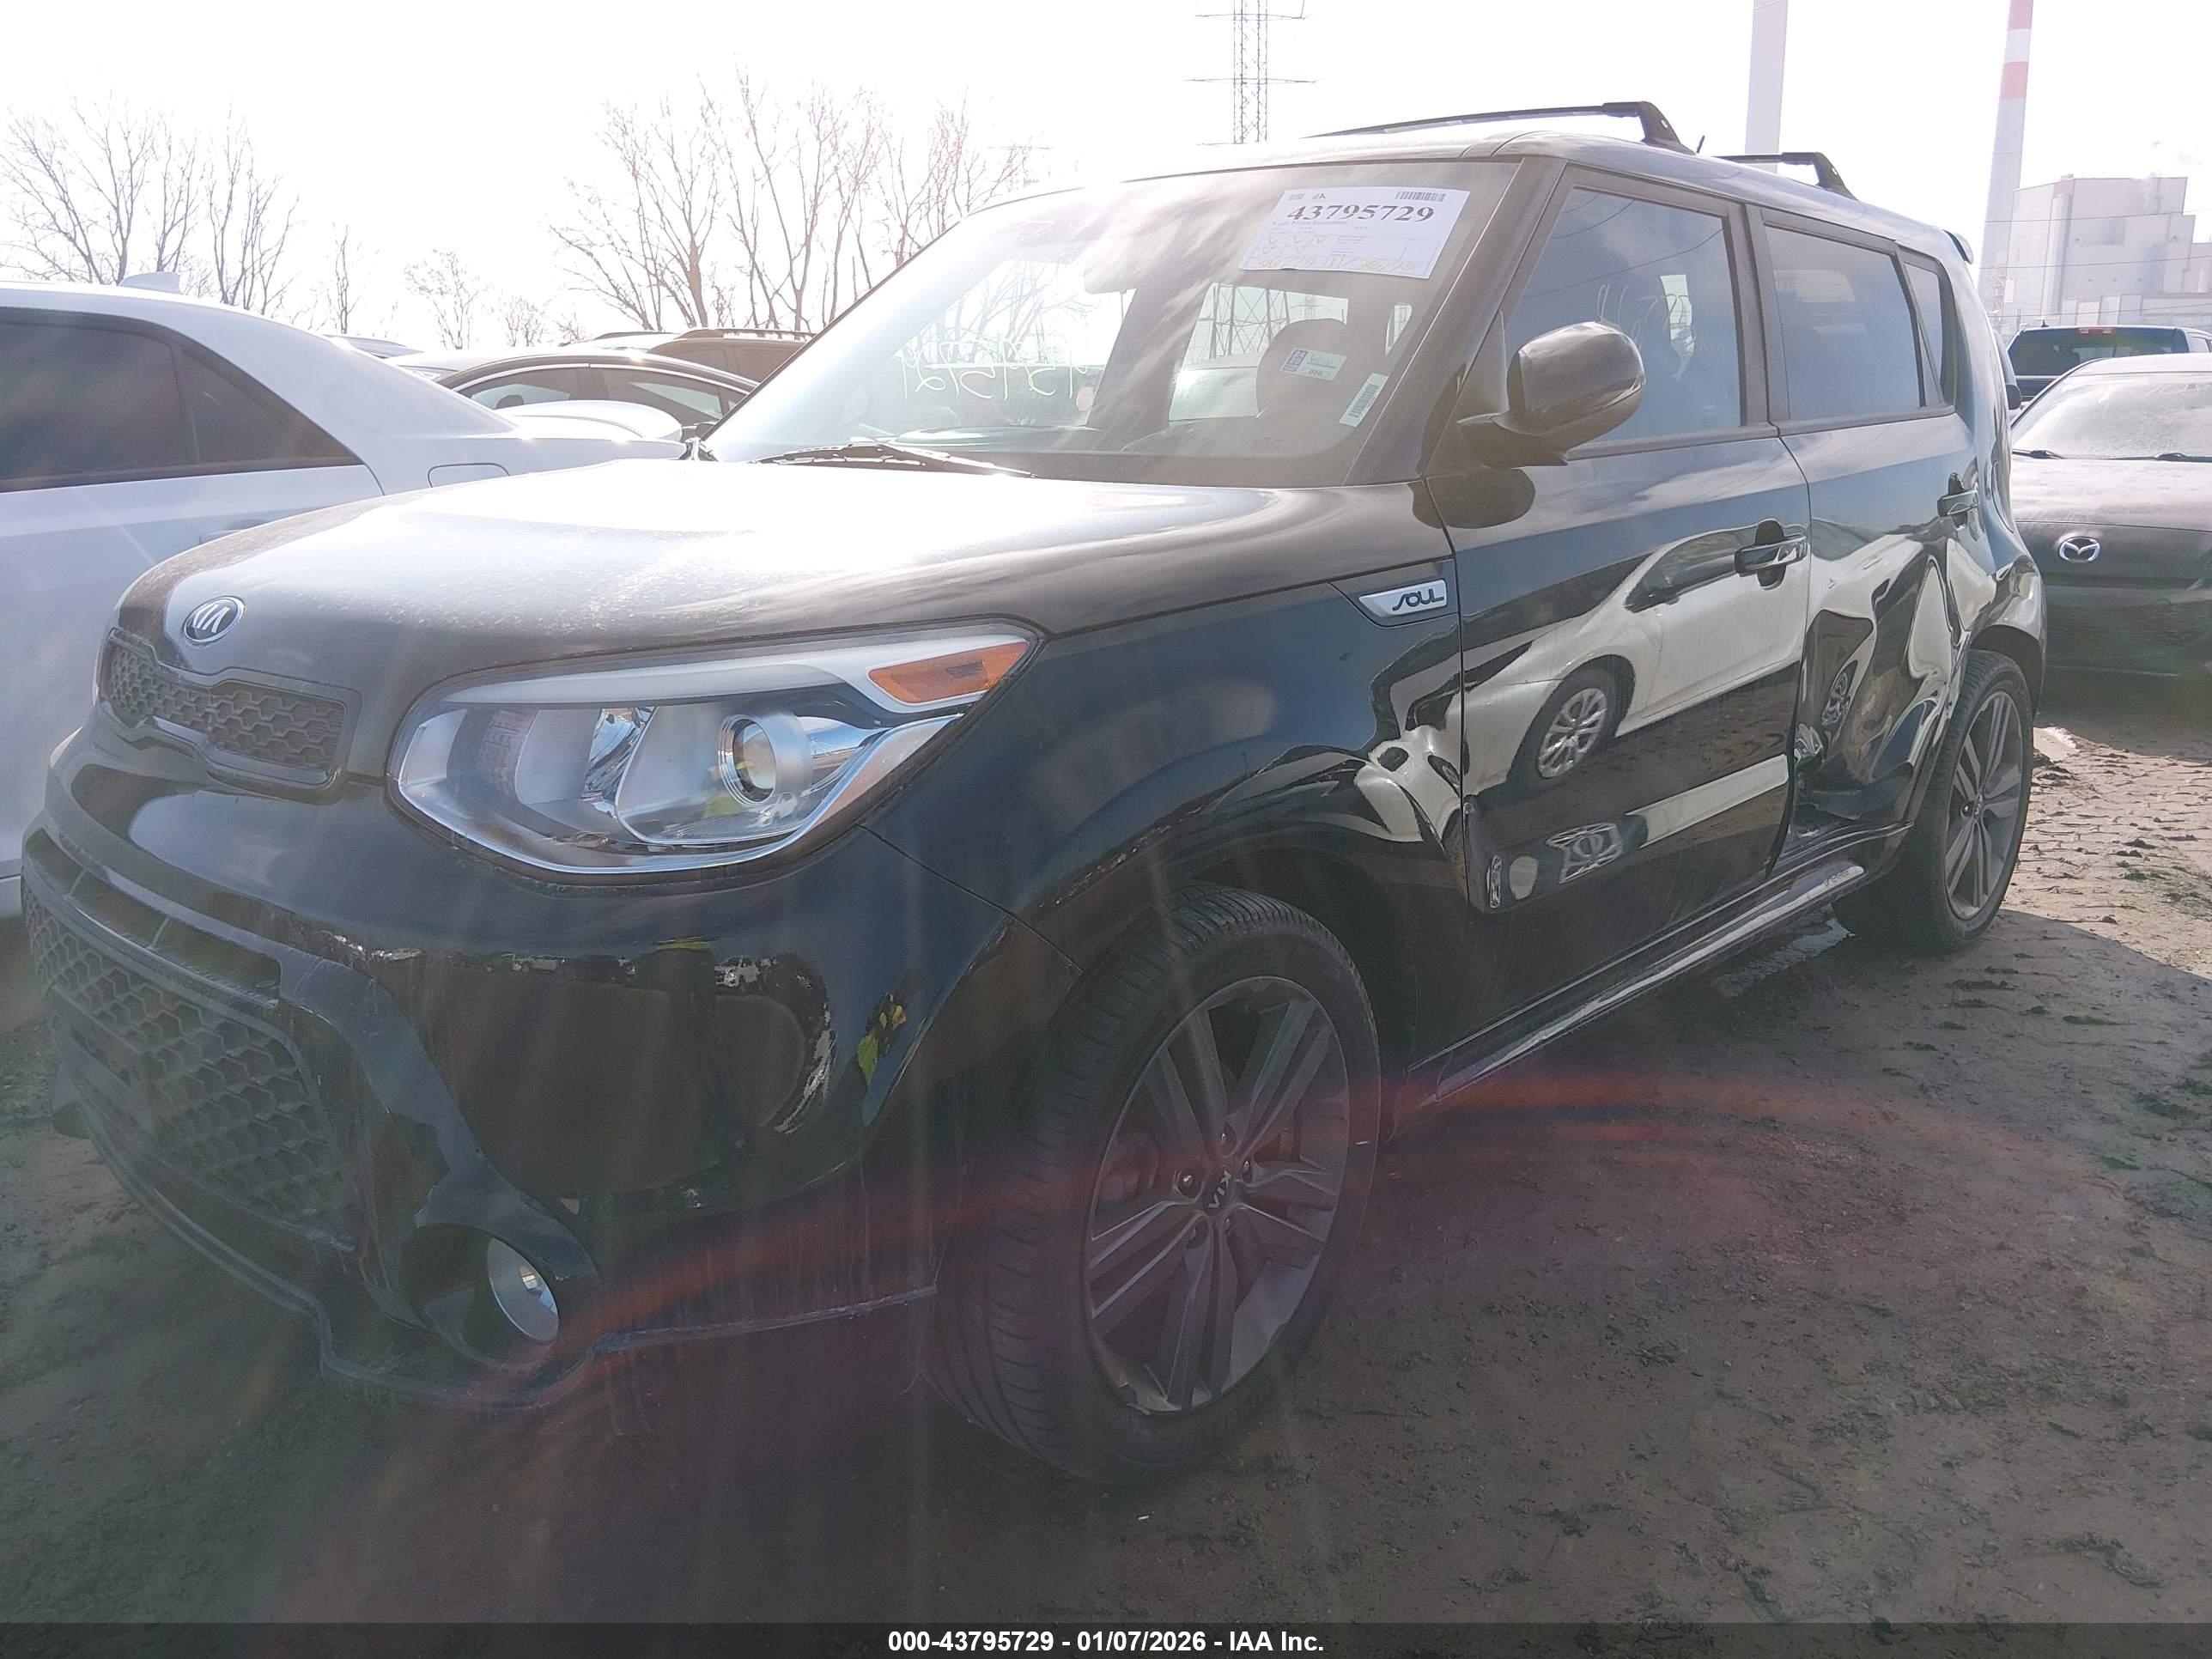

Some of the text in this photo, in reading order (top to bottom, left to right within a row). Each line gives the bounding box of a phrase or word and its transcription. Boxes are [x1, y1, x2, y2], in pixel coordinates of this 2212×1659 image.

[1286, 204, 1435, 222] 43795729
[1392, 588, 1445, 611] SOUL
[1207, 1169, 1232, 1210] KIA
